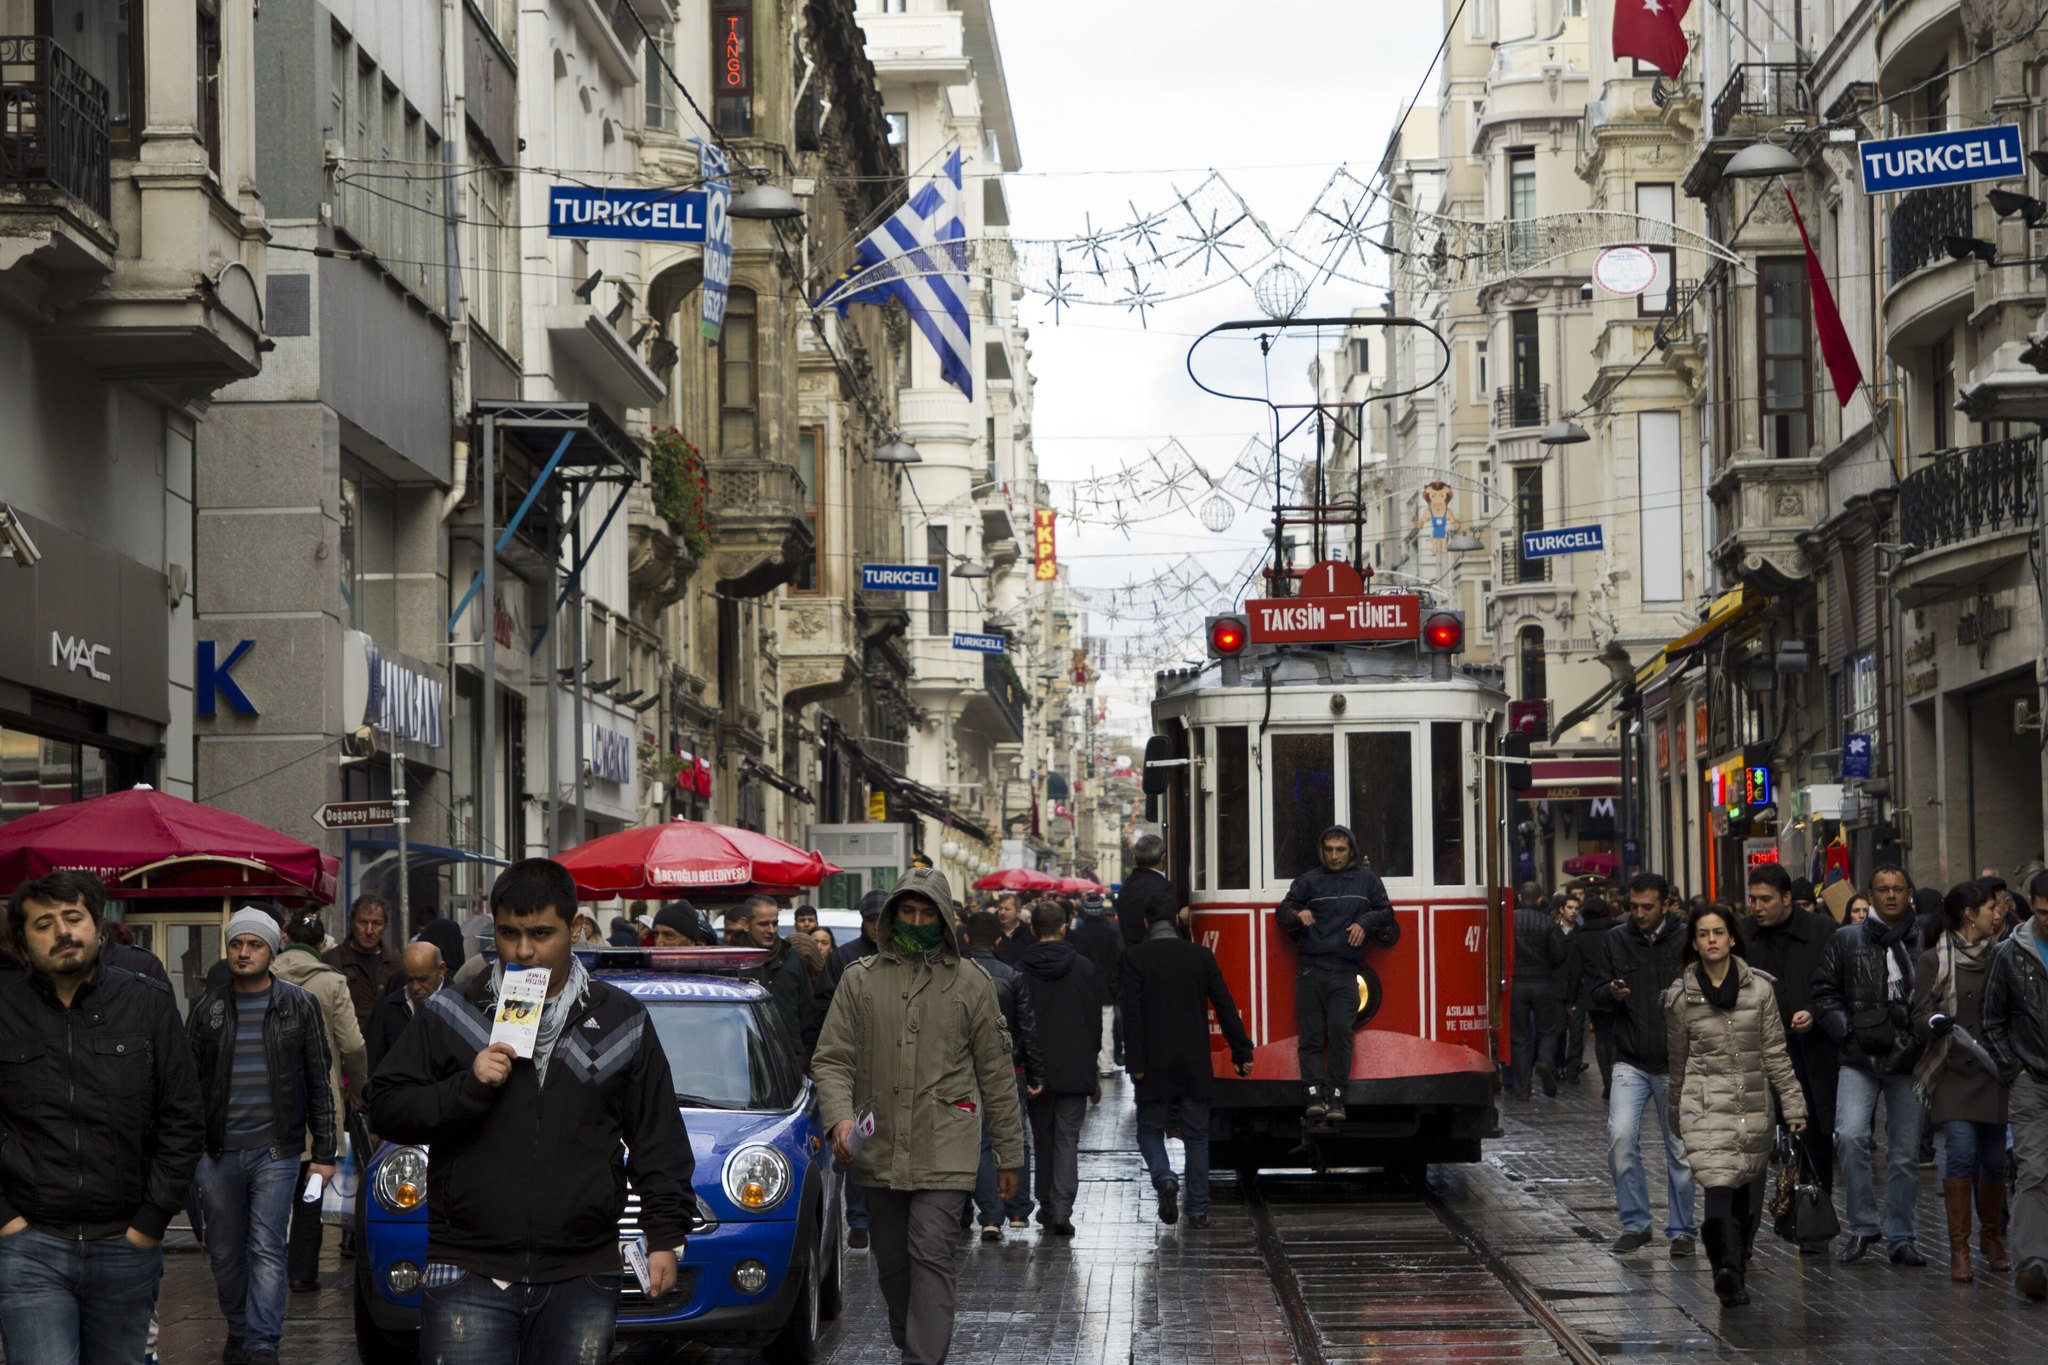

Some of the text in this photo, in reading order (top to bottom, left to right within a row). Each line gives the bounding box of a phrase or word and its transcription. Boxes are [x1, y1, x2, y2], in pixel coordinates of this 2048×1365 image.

[727, 17, 741, 85] TANGO
[1865, 138, 2018, 179] TURKCELL
[553, 198, 703, 230] TURKCELL
[1038, 509, 1054, 558] TKP
[1526, 531, 1602, 552] TURKCELL
[864, 569, 937, 585] TURKCELL
[1326, 565, 1335, 593] 1
[1261, 603, 1326, 632] TAKSİM
[52, 630, 111, 682] MAC
[954, 635, 1003, 650] TURKCELL
[197, 640, 260, 717] K
[375, 654, 444, 748] HALKBANK
[1547, 787, 1580, 798] MADO
[326, 806, 396, 824] Doğançay Müzes
[662, 866, 746, 883] BEYOĞLU BELEDİYESİ
[1465, 925, 1481, 952] 47
[630, 983, 742, 998] ZABITA
[1446, 1021, 1456, 1032] VE
